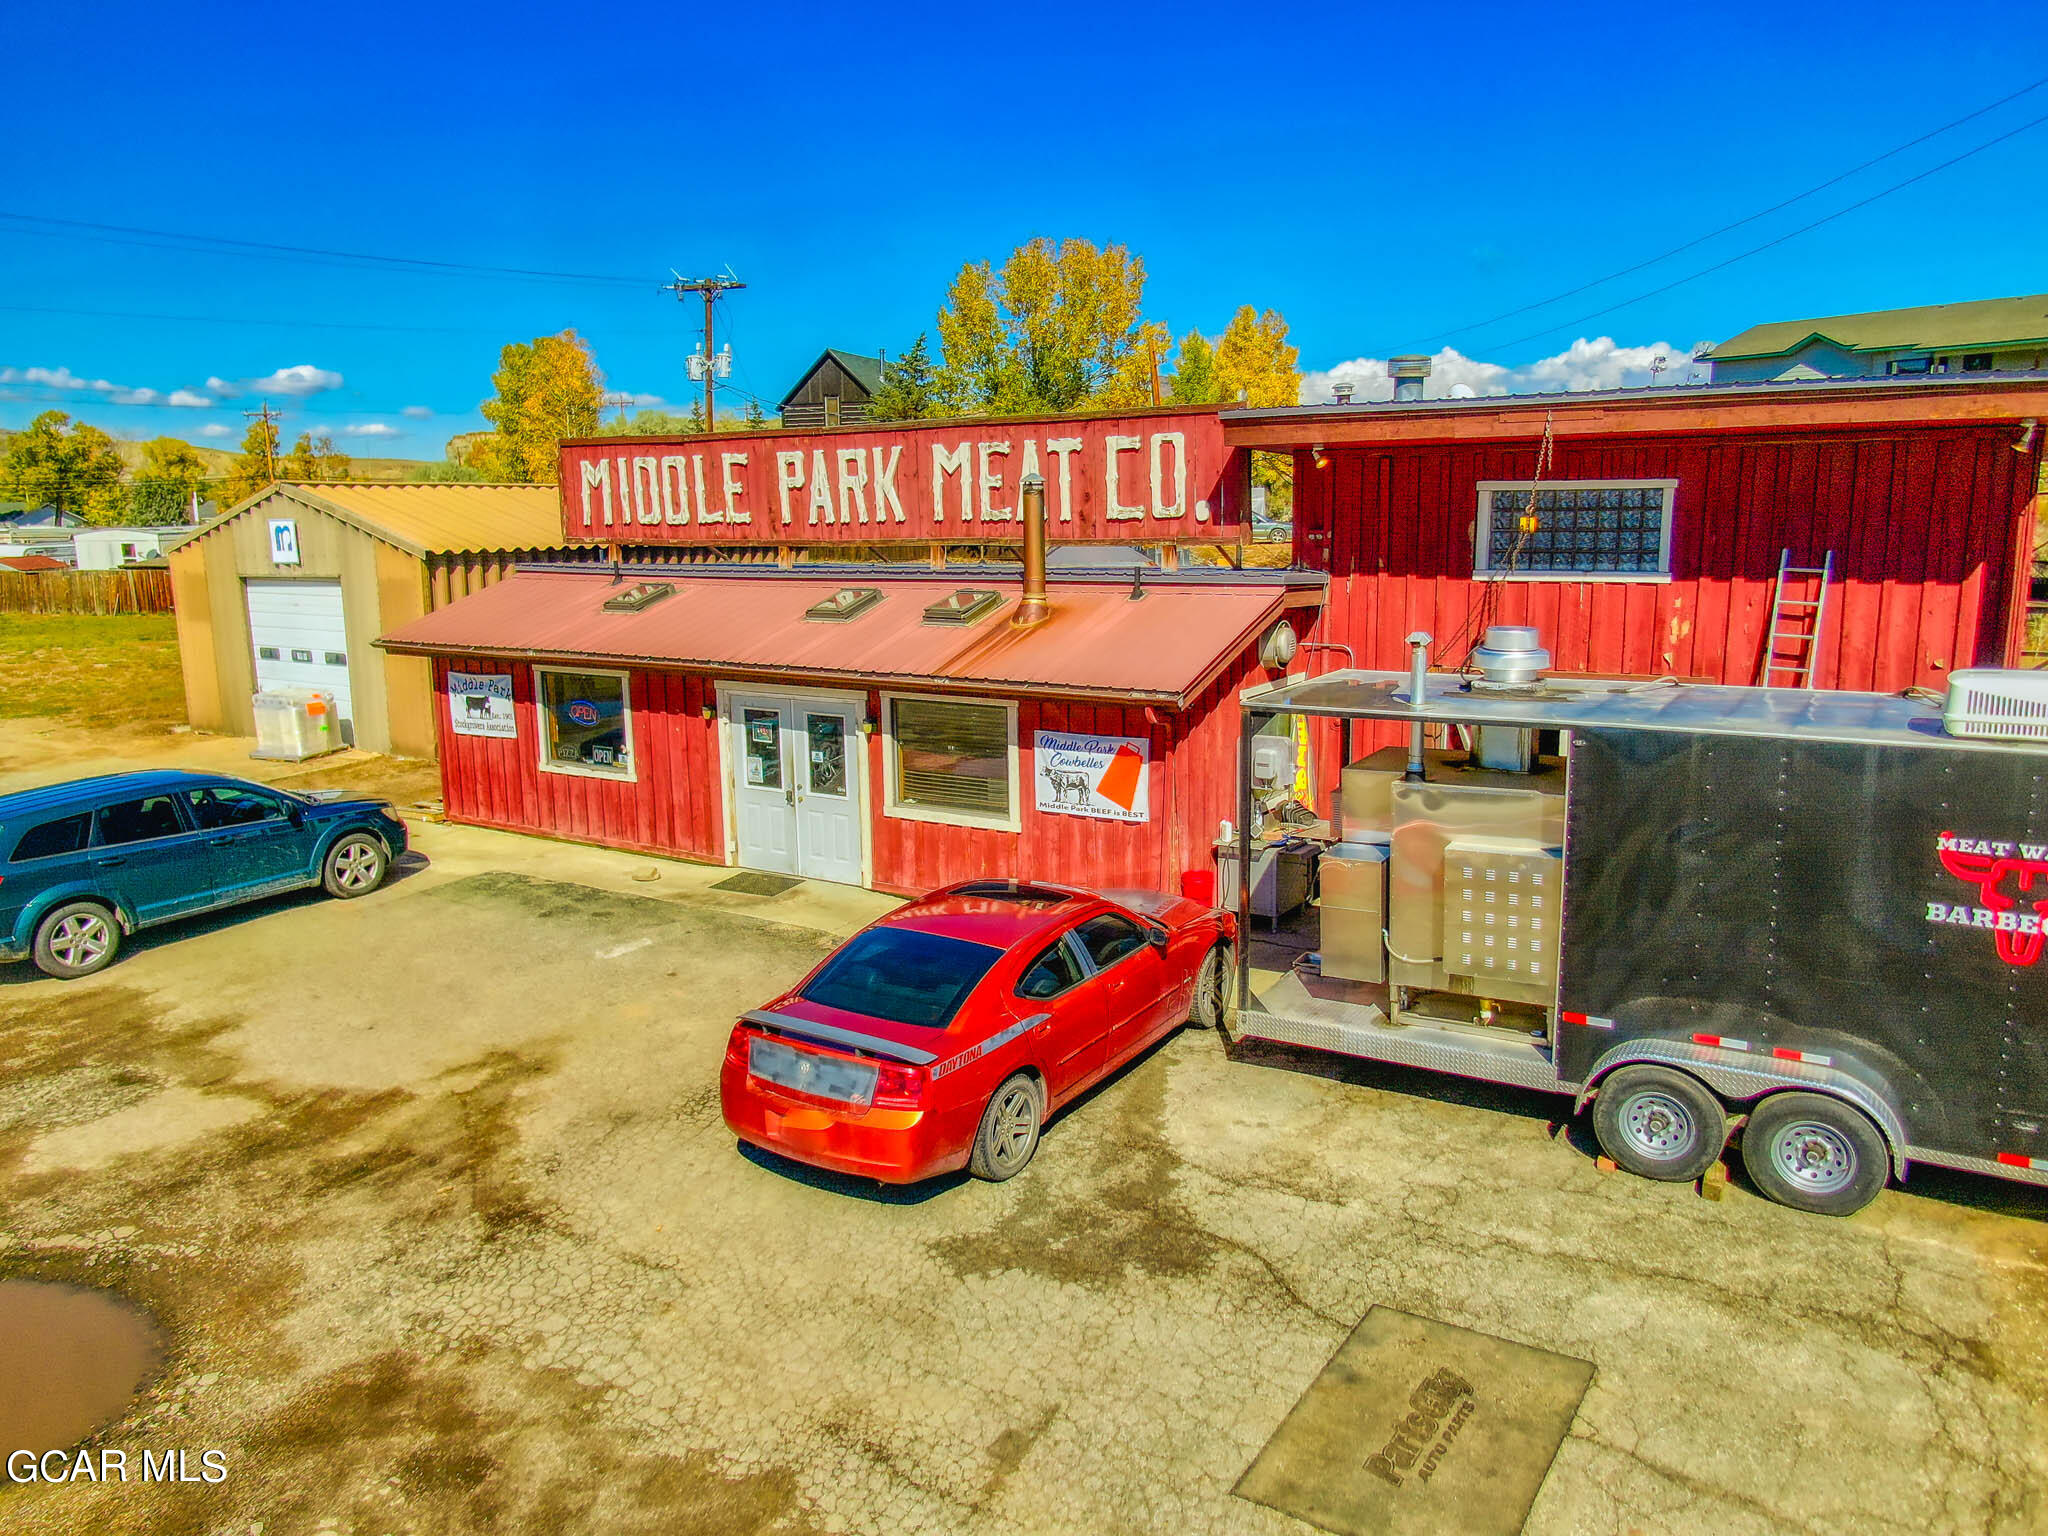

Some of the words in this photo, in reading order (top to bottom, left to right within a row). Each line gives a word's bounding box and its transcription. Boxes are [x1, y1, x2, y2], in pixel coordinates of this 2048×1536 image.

[579, 452, 752, 526] MIDDLE
[776, 445, 906, 525] PARK
[931, 437, 1083, 525] MEAT
[1105, 431, 1211, 521] CO.
[450, 677, 484, 697] Middle
[488, 679, 511, 701] Park
[571, 705, 598, 722] OPEN
[1040, 734, 1083, 752] Middle
[1083, 739, 1117, 755] Park
[594, 749, 612, 764] OPEN
[1050, 752, 1105, 769] Cowbelles
[1039, 801, 1069, 811] Middle
[1070, 805, 1089, 813] Park
[1091, 807, 1112, 815] BEEF
[1113, 809, 1121, 817] is
[1936, 837, 2010, 857] MEAT
[939, 1044, 983, 1077] DAYTONA
[1418, 1442, 1448, 1483] AUTO
